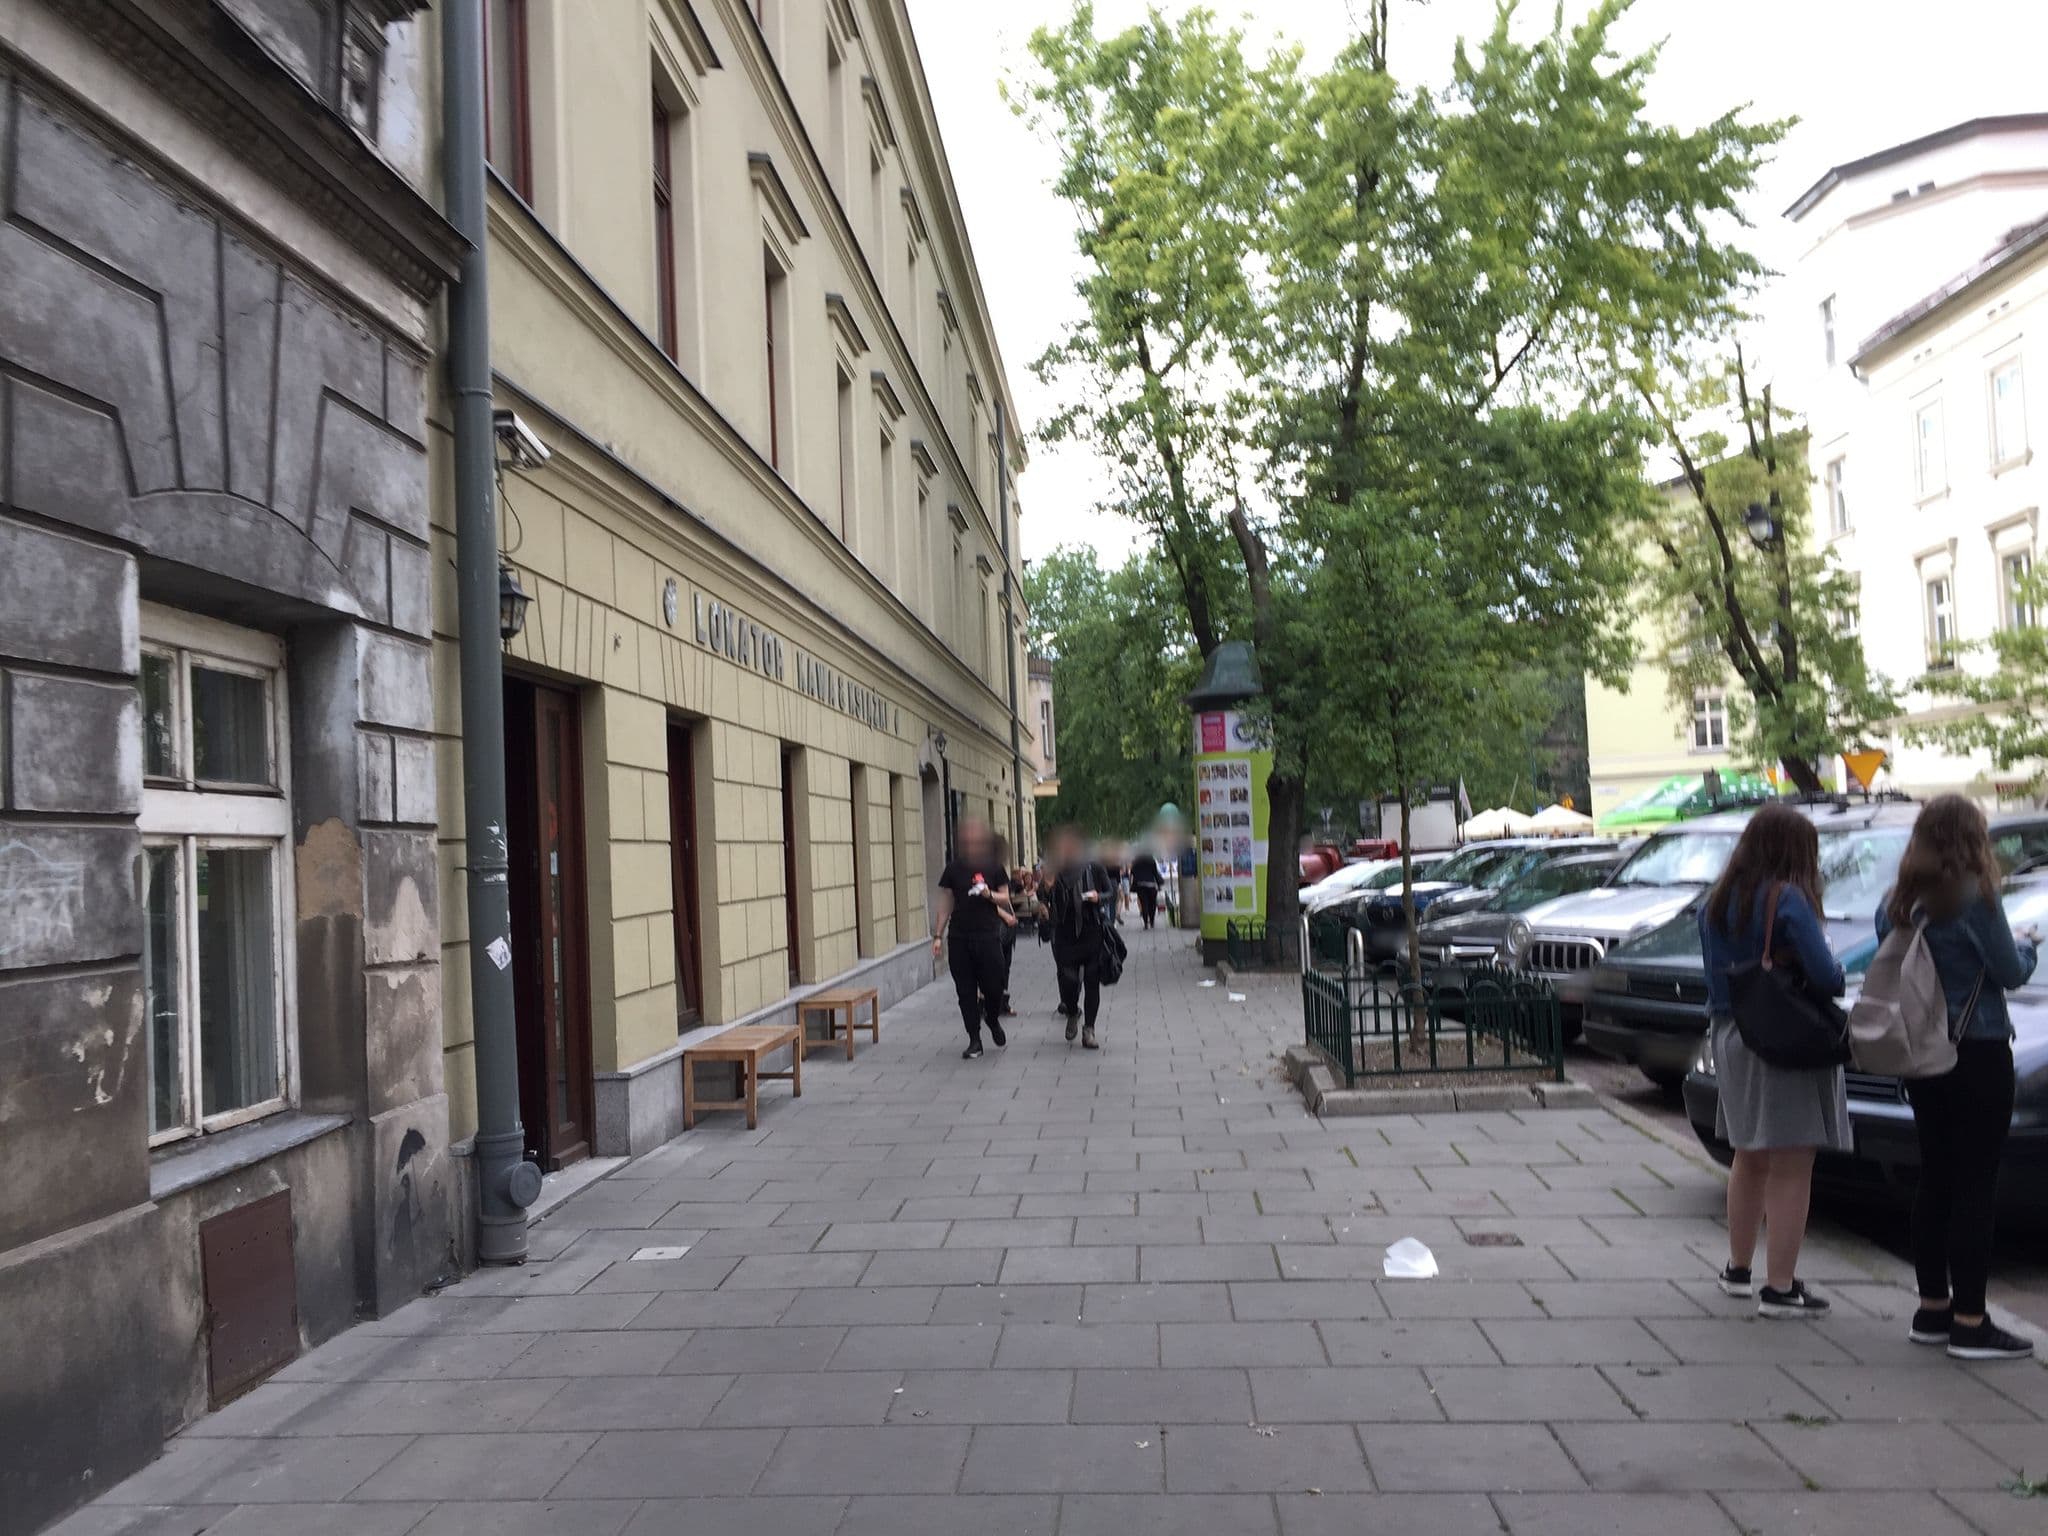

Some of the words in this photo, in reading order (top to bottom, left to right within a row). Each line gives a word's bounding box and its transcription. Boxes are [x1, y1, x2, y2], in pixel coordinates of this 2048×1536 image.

[693, 592, 784, 681] LOKATOR
[796, 651, 836, 707] KAWA
[837, 675, 846, 711] &
[847, 680, 888, 731] KSIĄŻKI
